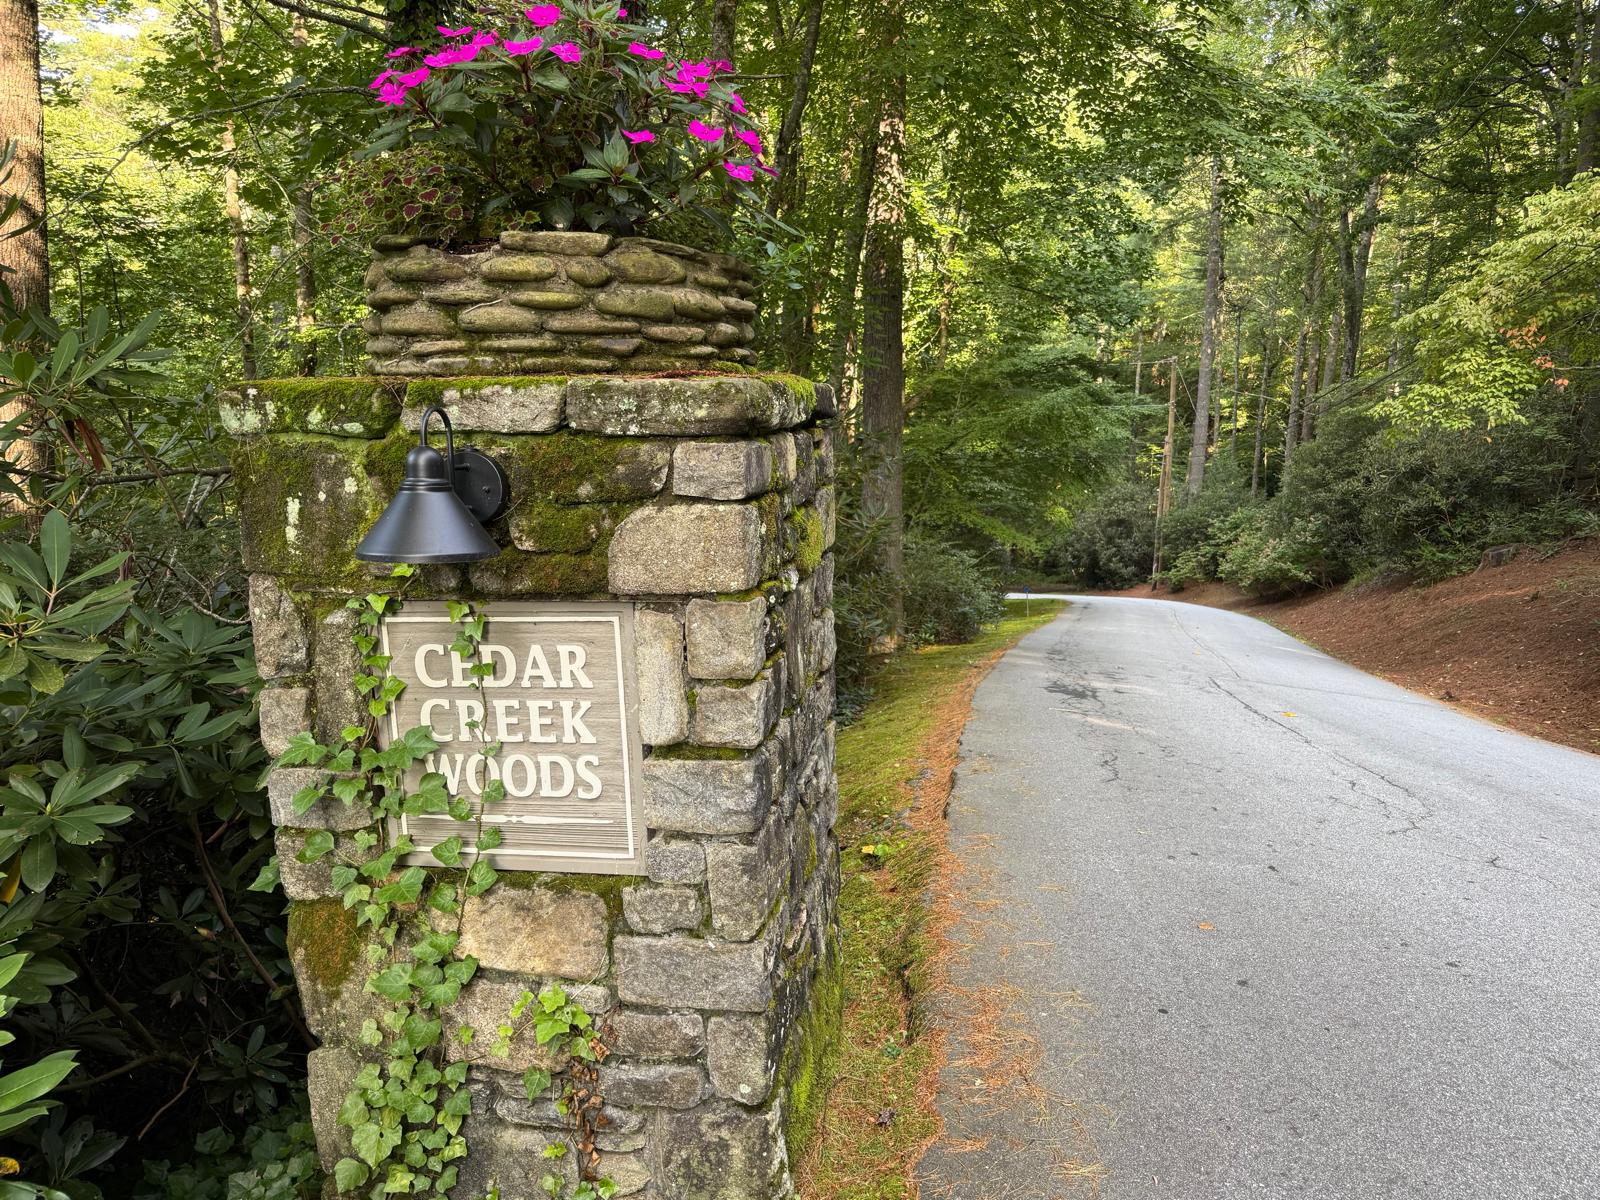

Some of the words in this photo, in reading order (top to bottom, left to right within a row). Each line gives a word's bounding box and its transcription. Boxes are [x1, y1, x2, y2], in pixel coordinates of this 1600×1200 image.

[414, 643, 594, 689] CEDAR
[420, 698, 597, 744] CREEK
[423, 753, 603, 800] WOODS
